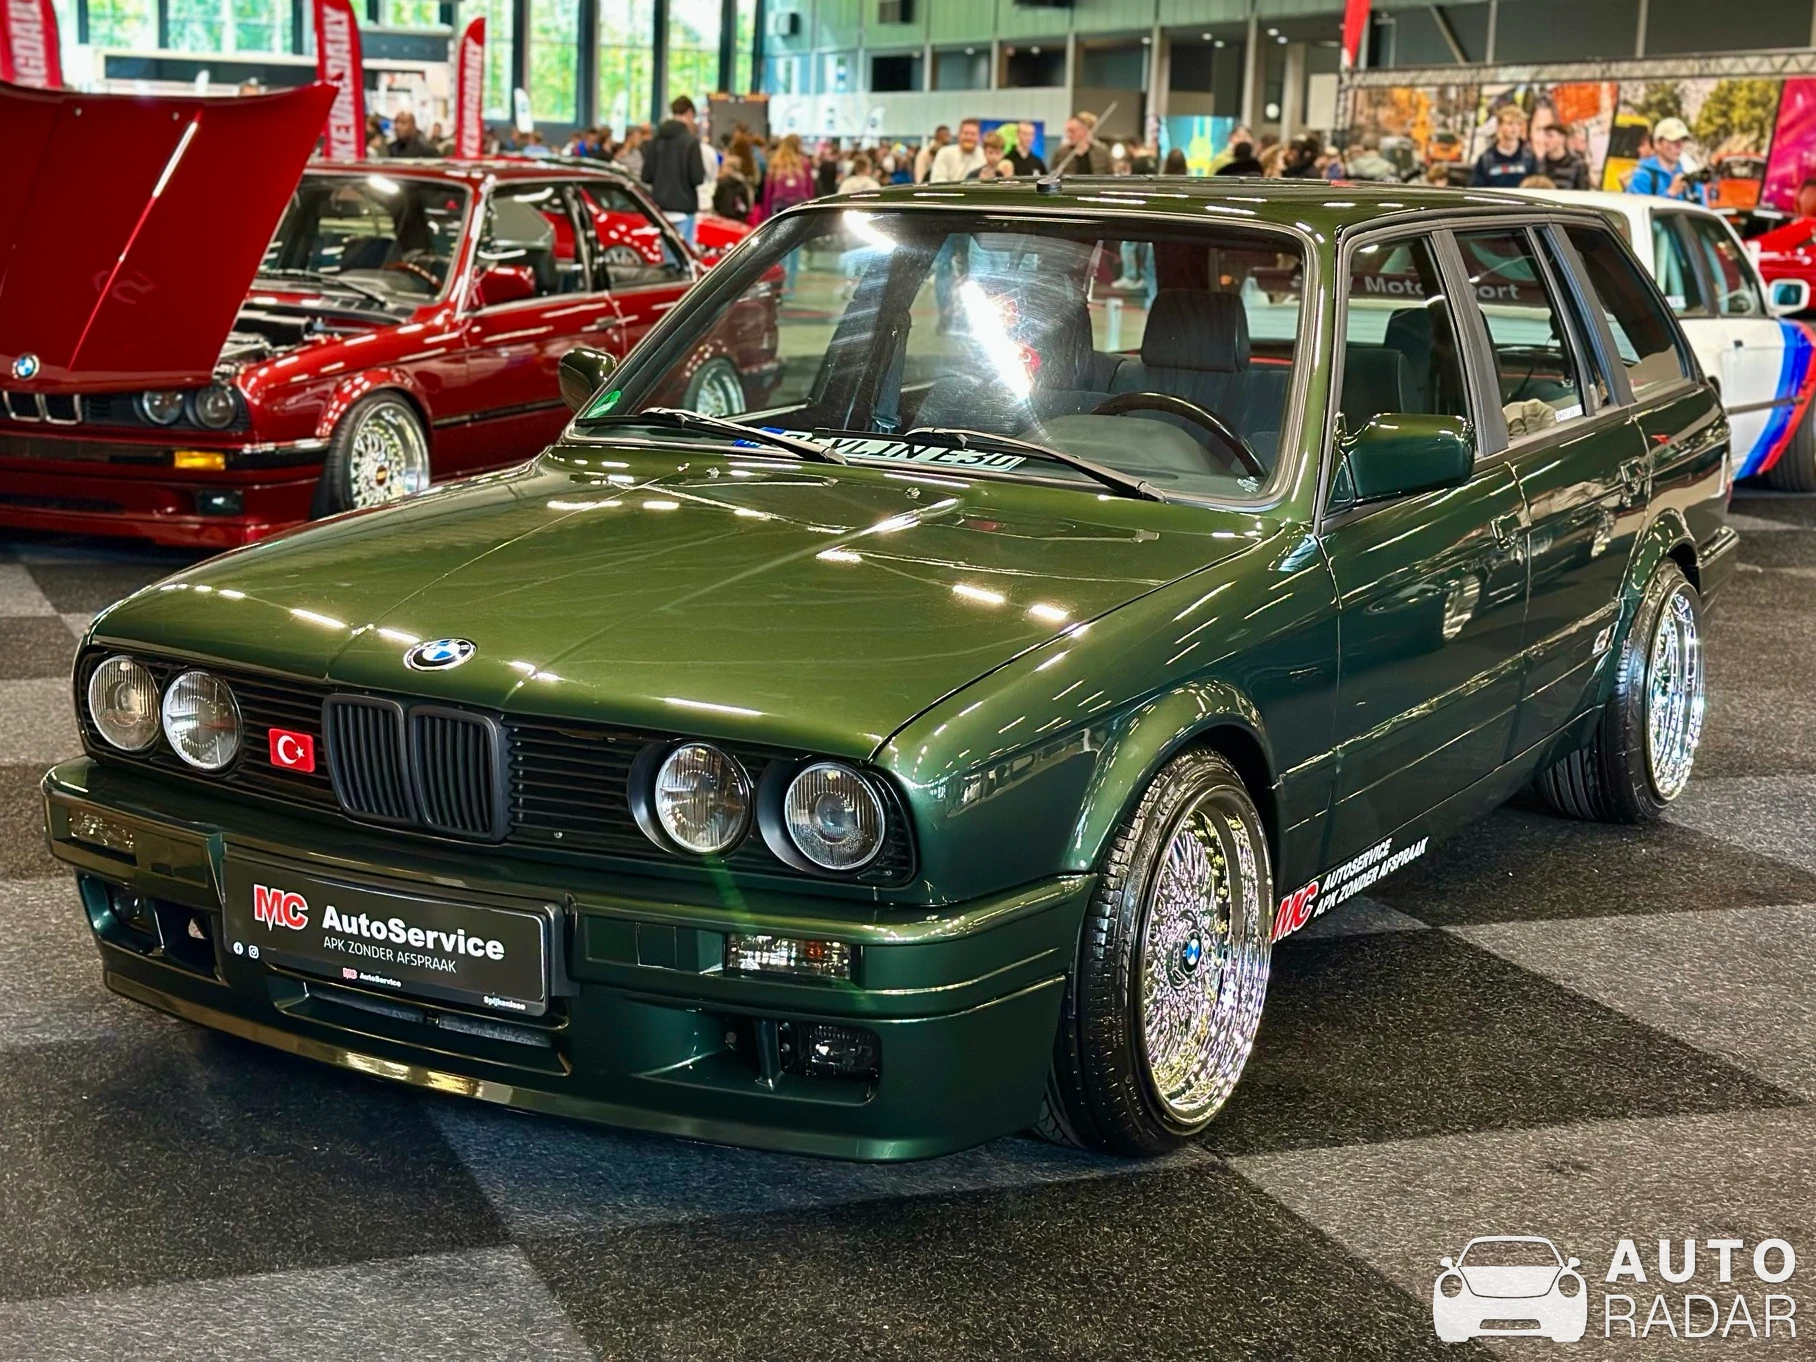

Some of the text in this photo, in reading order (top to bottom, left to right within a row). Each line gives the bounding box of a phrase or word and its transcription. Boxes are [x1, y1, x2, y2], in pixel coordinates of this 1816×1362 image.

[1313, 837, 1429, 918] APK ZONDER AFSPRAAK
[1321, 838, 1393, 893] AUTOSERVICE
[253, 884, 309, 931] MC
[322, 905, 505, 960] AutoService
[1272, 881, 1320, 944] MC
[323, 936, 457, 974] APK ZONDER AFSPRAAK
[360, 972, 402, 988] AutoService
